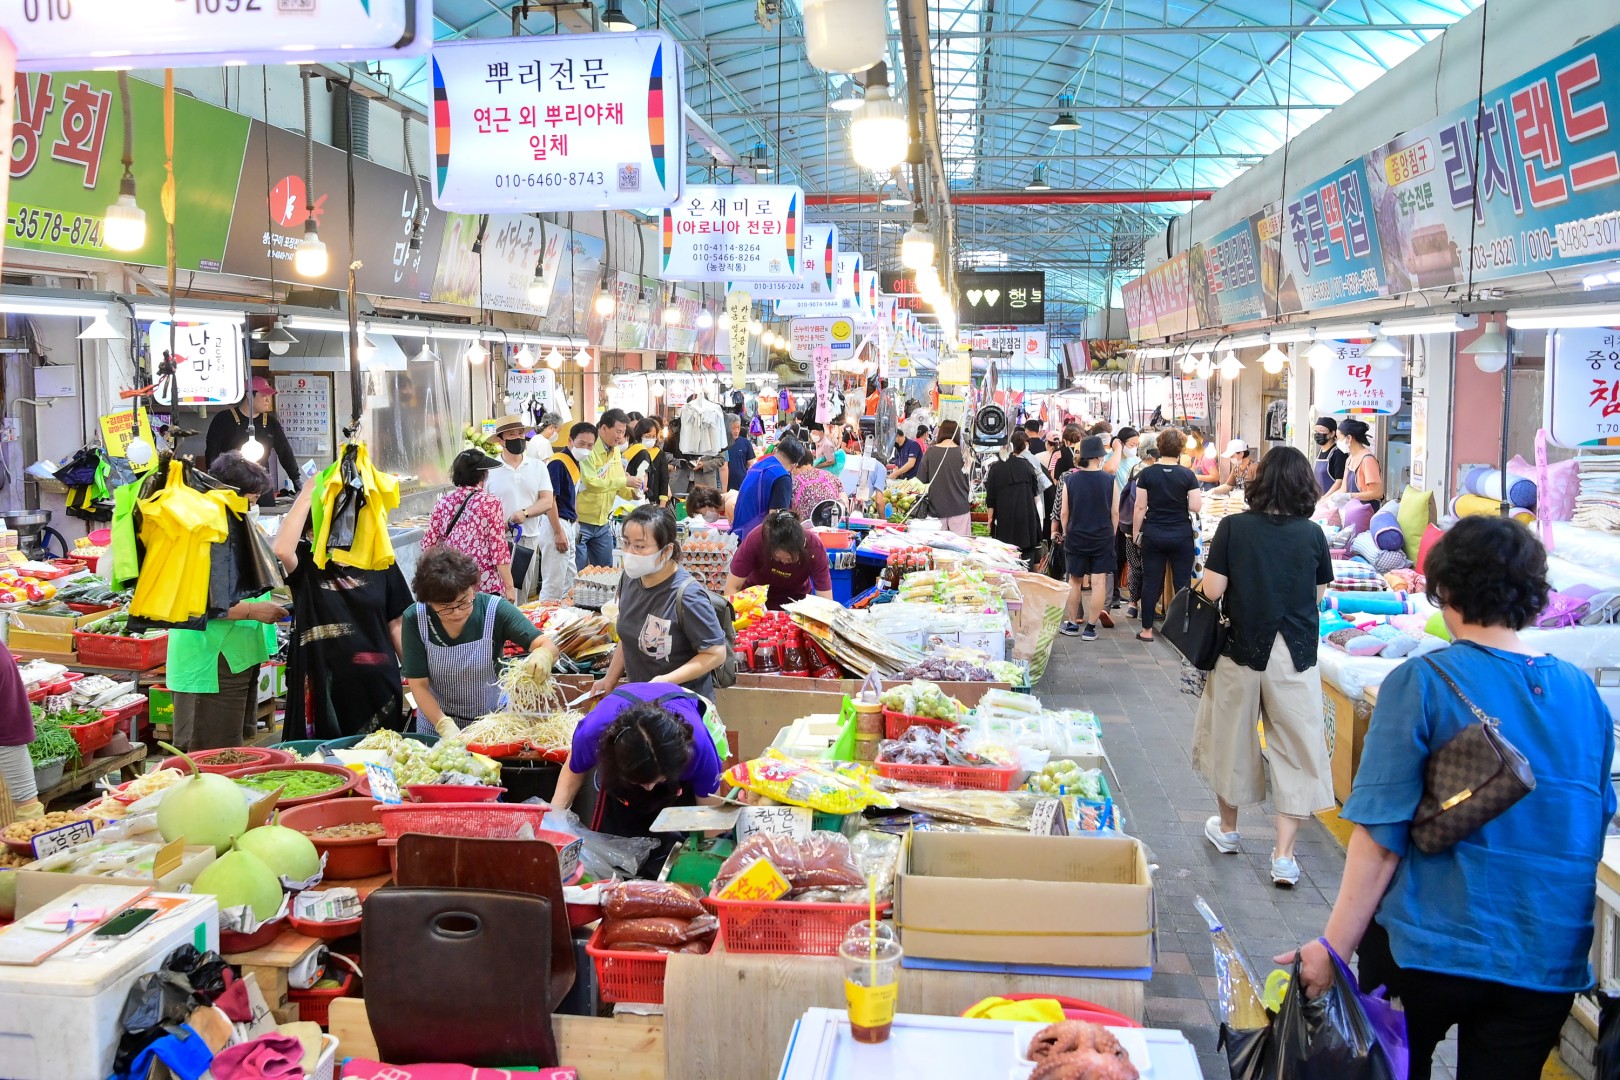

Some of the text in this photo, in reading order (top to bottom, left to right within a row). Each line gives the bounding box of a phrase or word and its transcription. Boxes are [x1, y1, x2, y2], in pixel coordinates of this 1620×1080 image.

[485, 58, 609, 94] 뿌리전문
[474, 102, 624, 134] 연근 외 뿌리야채
[529, 134, 568, 160] 일체
[1440, 53, 1620, 224] 리치랜드
[1391, 145, 1428, 182] 중앙침구
[496, 172, 604, 188] 010-6460-8743
[687, 198, 773, 217] 온새미로
[1399, 182, 1435, 217] 혼수전문
[676, 220, 782, 235] (아로니아 전문)
[1288, 170, 1371, 276] 종로떡집
[693, 244, 760, 252] 010-4114-8264
[706, 262, 746, 272] (농장직통)
[189, 330, 212, 380] 낭만
[298, 379, 306, 388] 9
[1347, 364, 1372, 388] 떡
